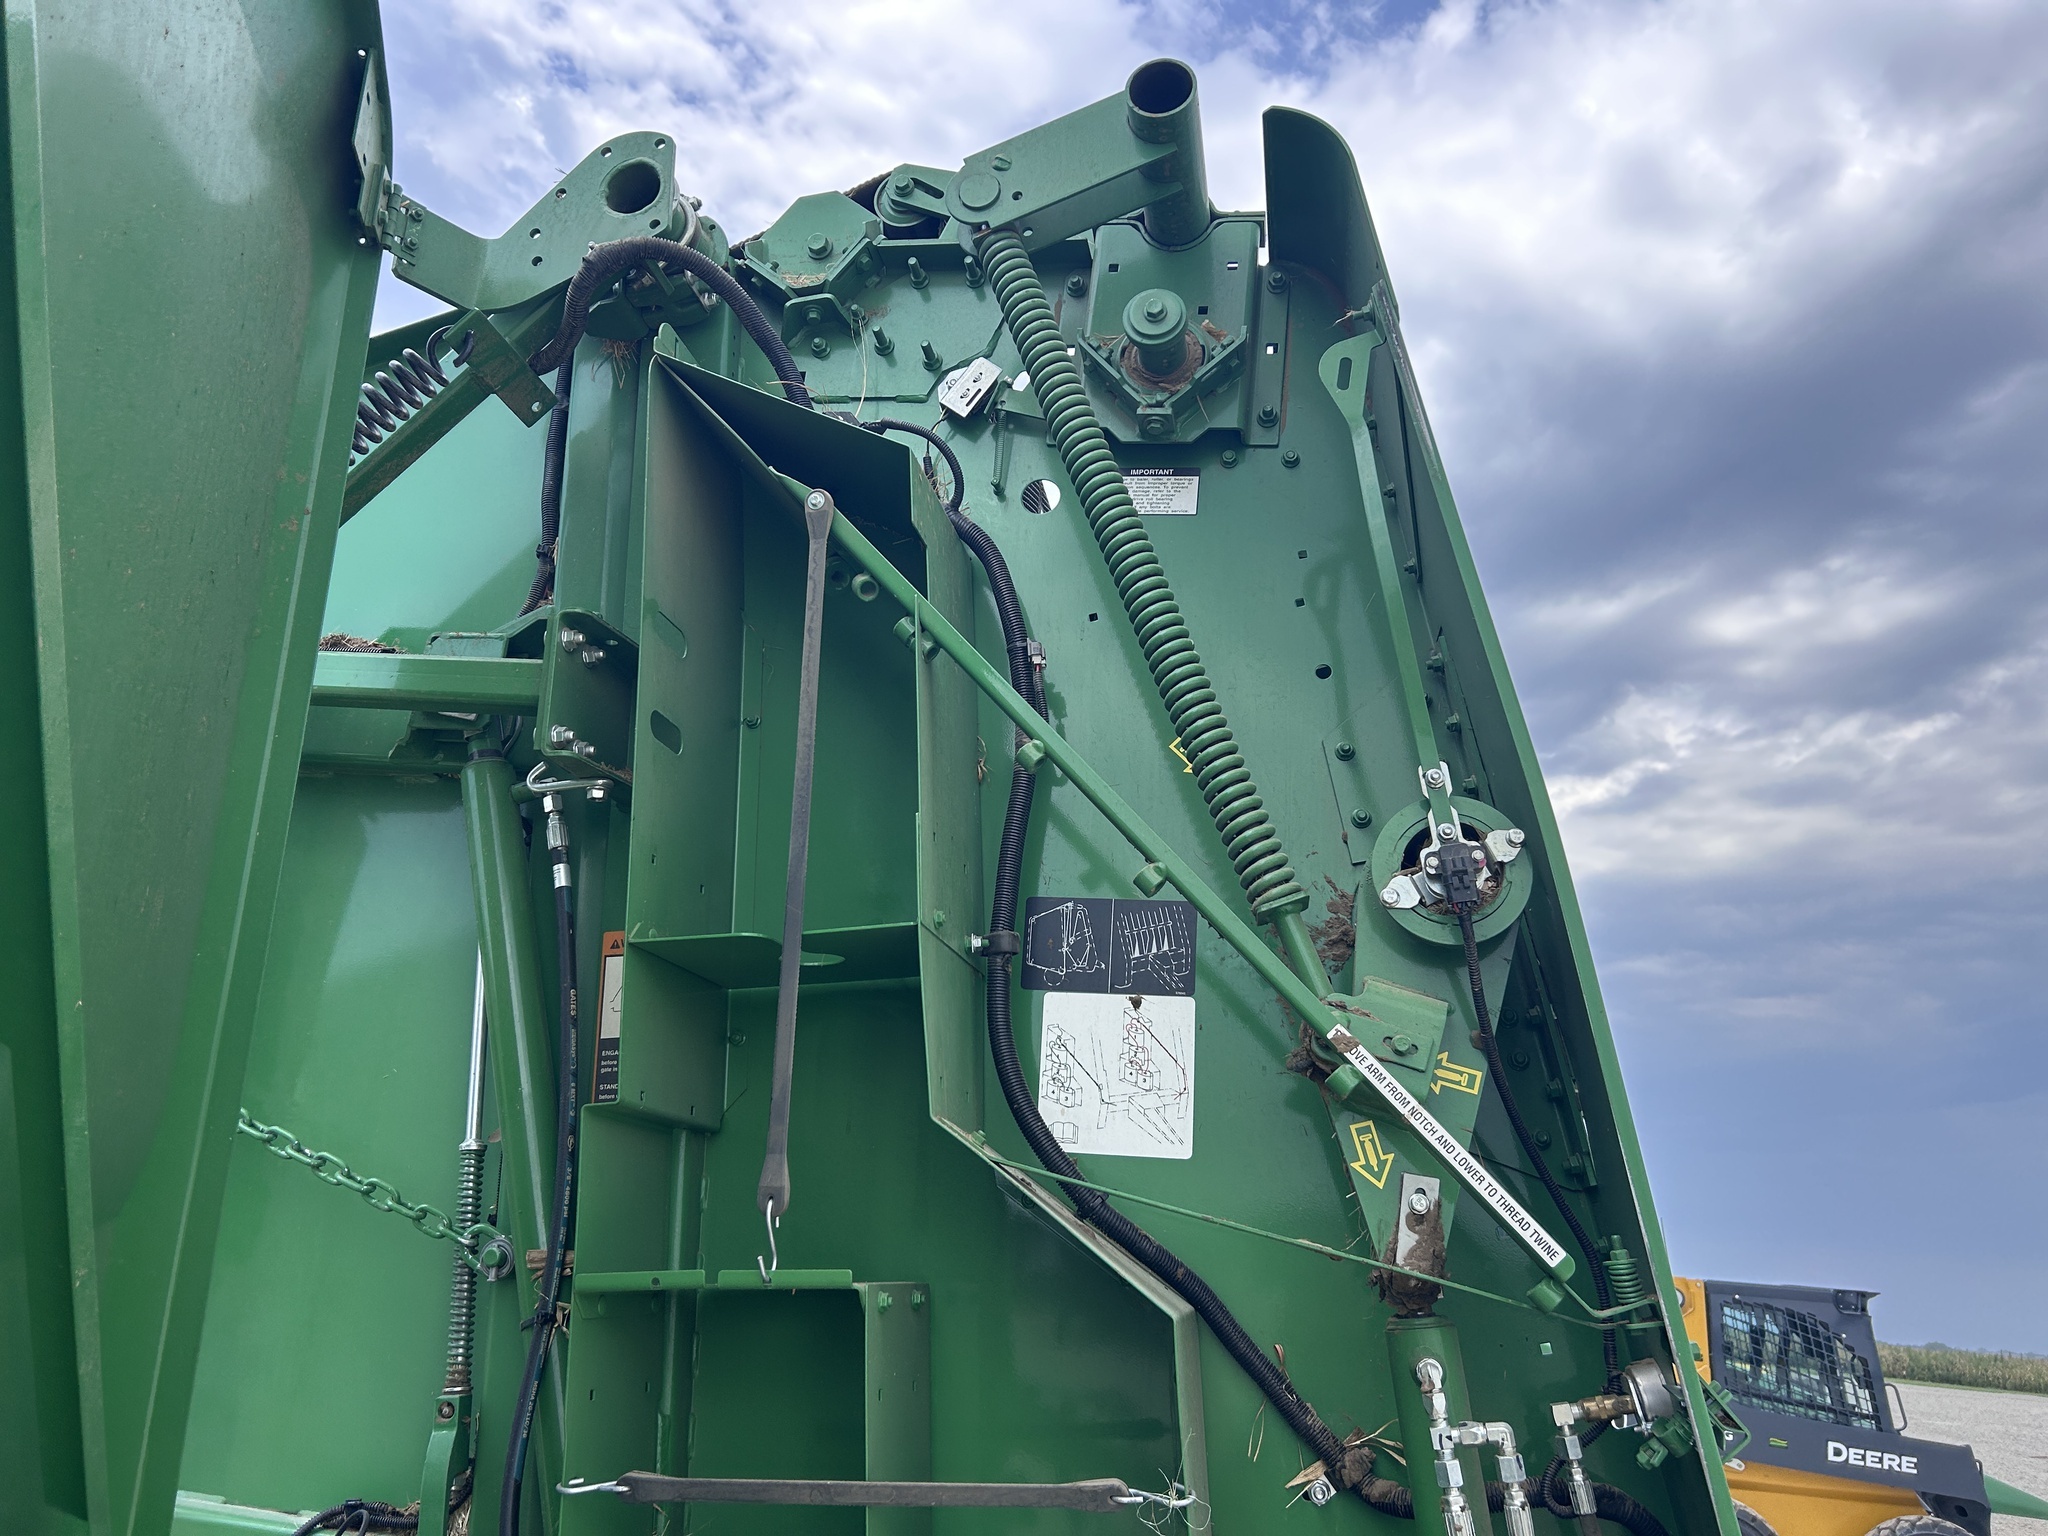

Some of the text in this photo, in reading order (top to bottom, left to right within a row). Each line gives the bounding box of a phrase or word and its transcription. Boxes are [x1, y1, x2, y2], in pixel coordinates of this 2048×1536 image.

[1364, 1059, 1387, 1085] ARM
[1383, 1083, 1411, 1109] FROM
[1408, 1105, 1438, 1137] NOTCH
[1434, 1132, 1456, 1155] AND
[1453, 1152, 1486, 1186] LOWER
[1483, 1182, 1498, 1198] TO
[1495, 1196, 1530, 1232] THREAD
[1529, 1229, 1560, 1262] TWINE
[530, 1380, 539, 1400] MSHA
[1827, 1441, 1918, 1474] DEERE
